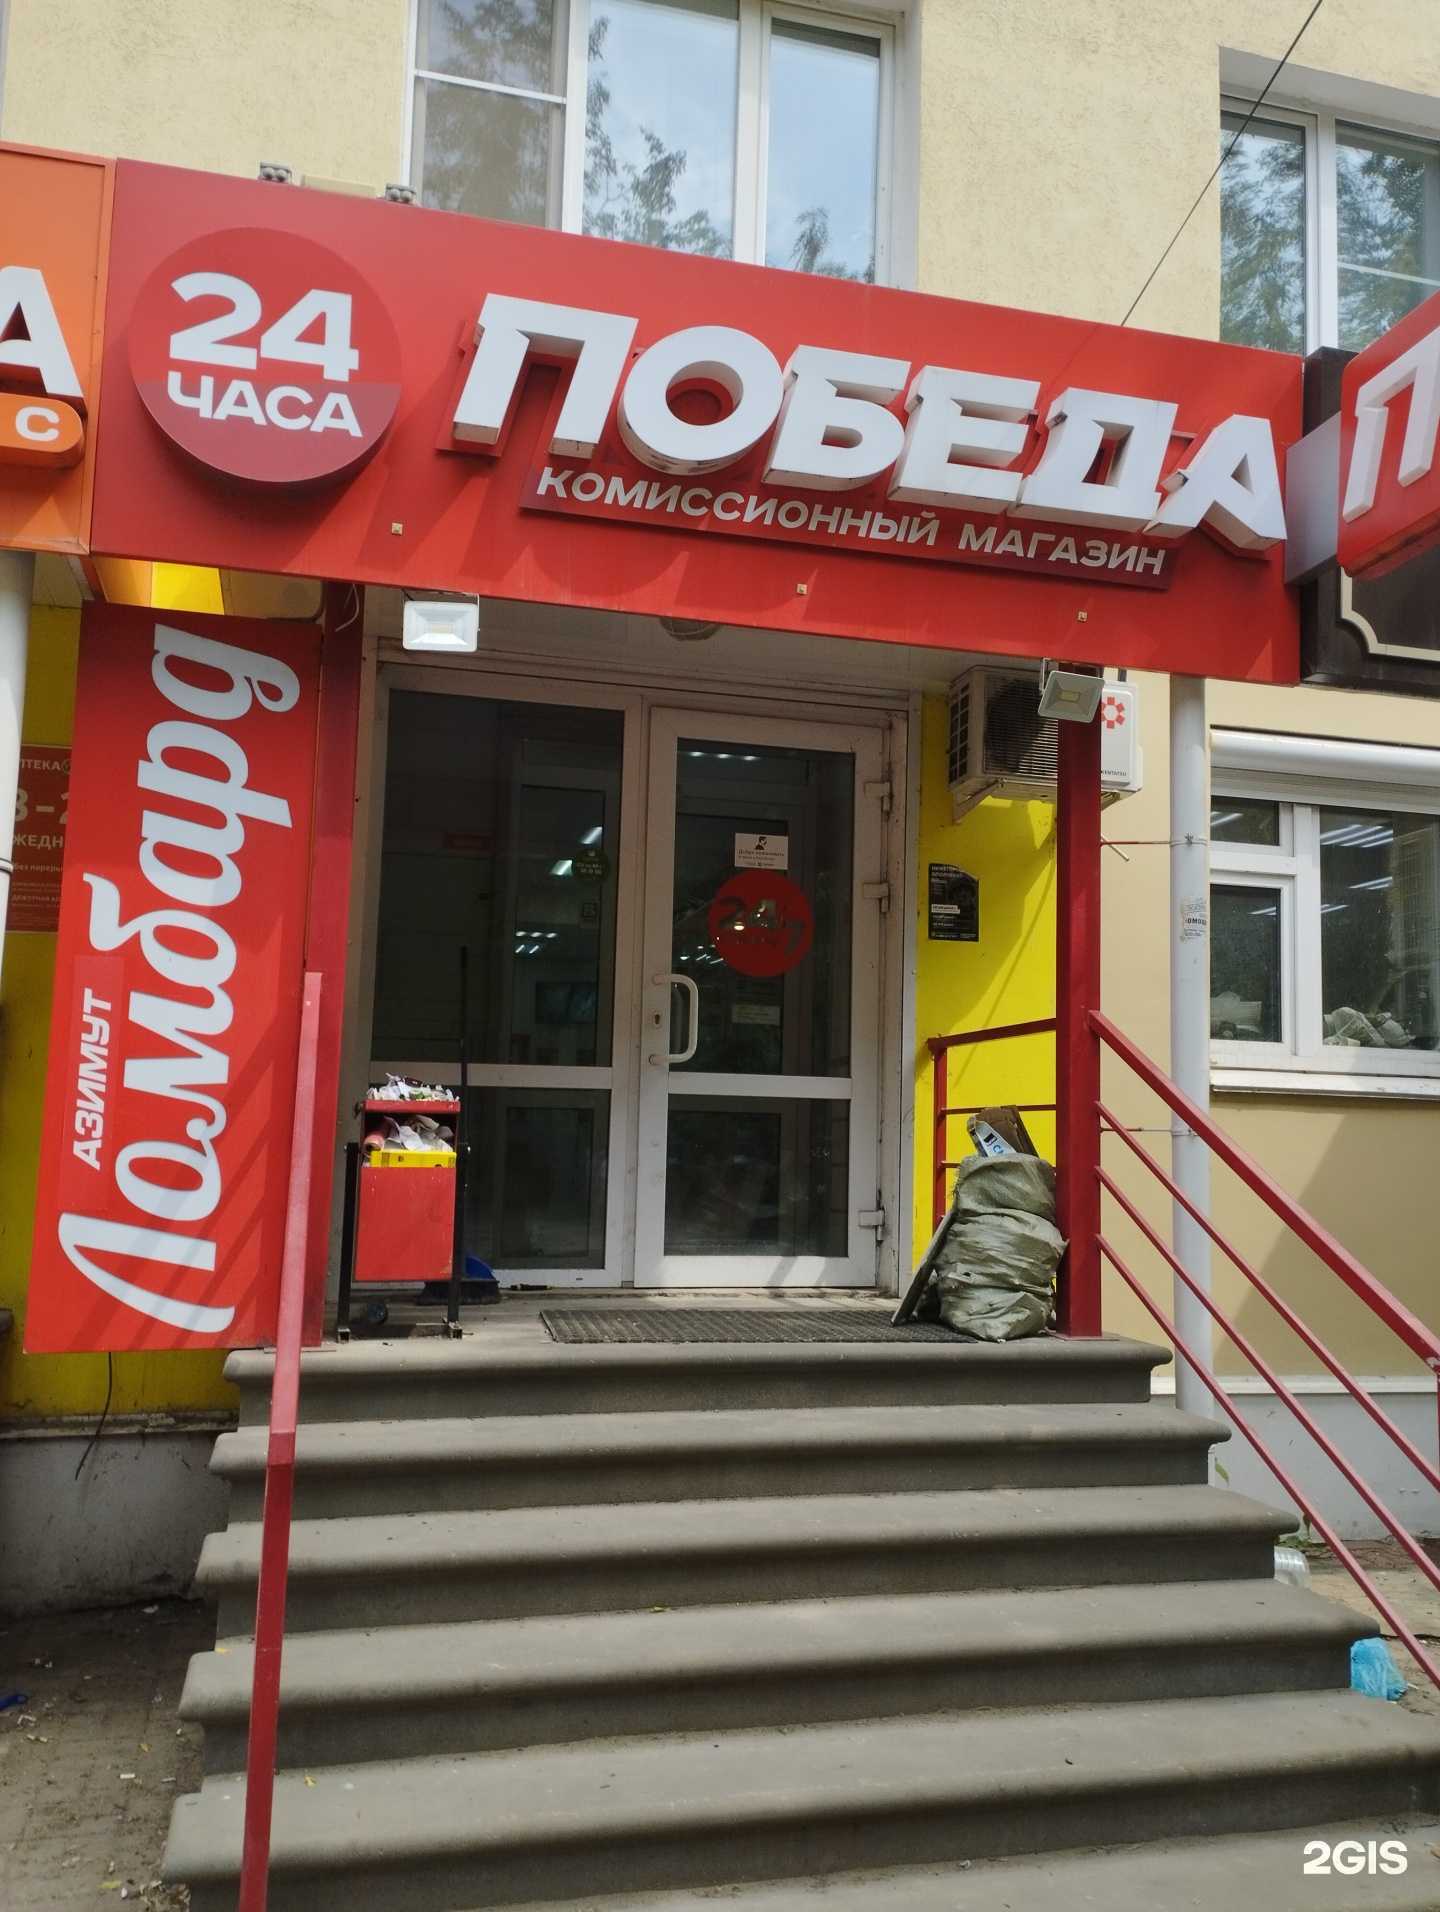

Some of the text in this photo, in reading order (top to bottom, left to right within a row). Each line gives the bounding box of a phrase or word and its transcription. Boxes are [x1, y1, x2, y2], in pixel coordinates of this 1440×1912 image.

[168, 271, 360, 383] 24
[166, 369, 364, 438] ЧАСА
[452, 293, 1288, 551] ПОБЕДА
[535, 466, 1167, 576] КОМИССИОННЫЙ МАГАЗИН
[58, 623, 301, 1334] Ломбард
[71, 988, 113, 1172] АЗИМУТ
